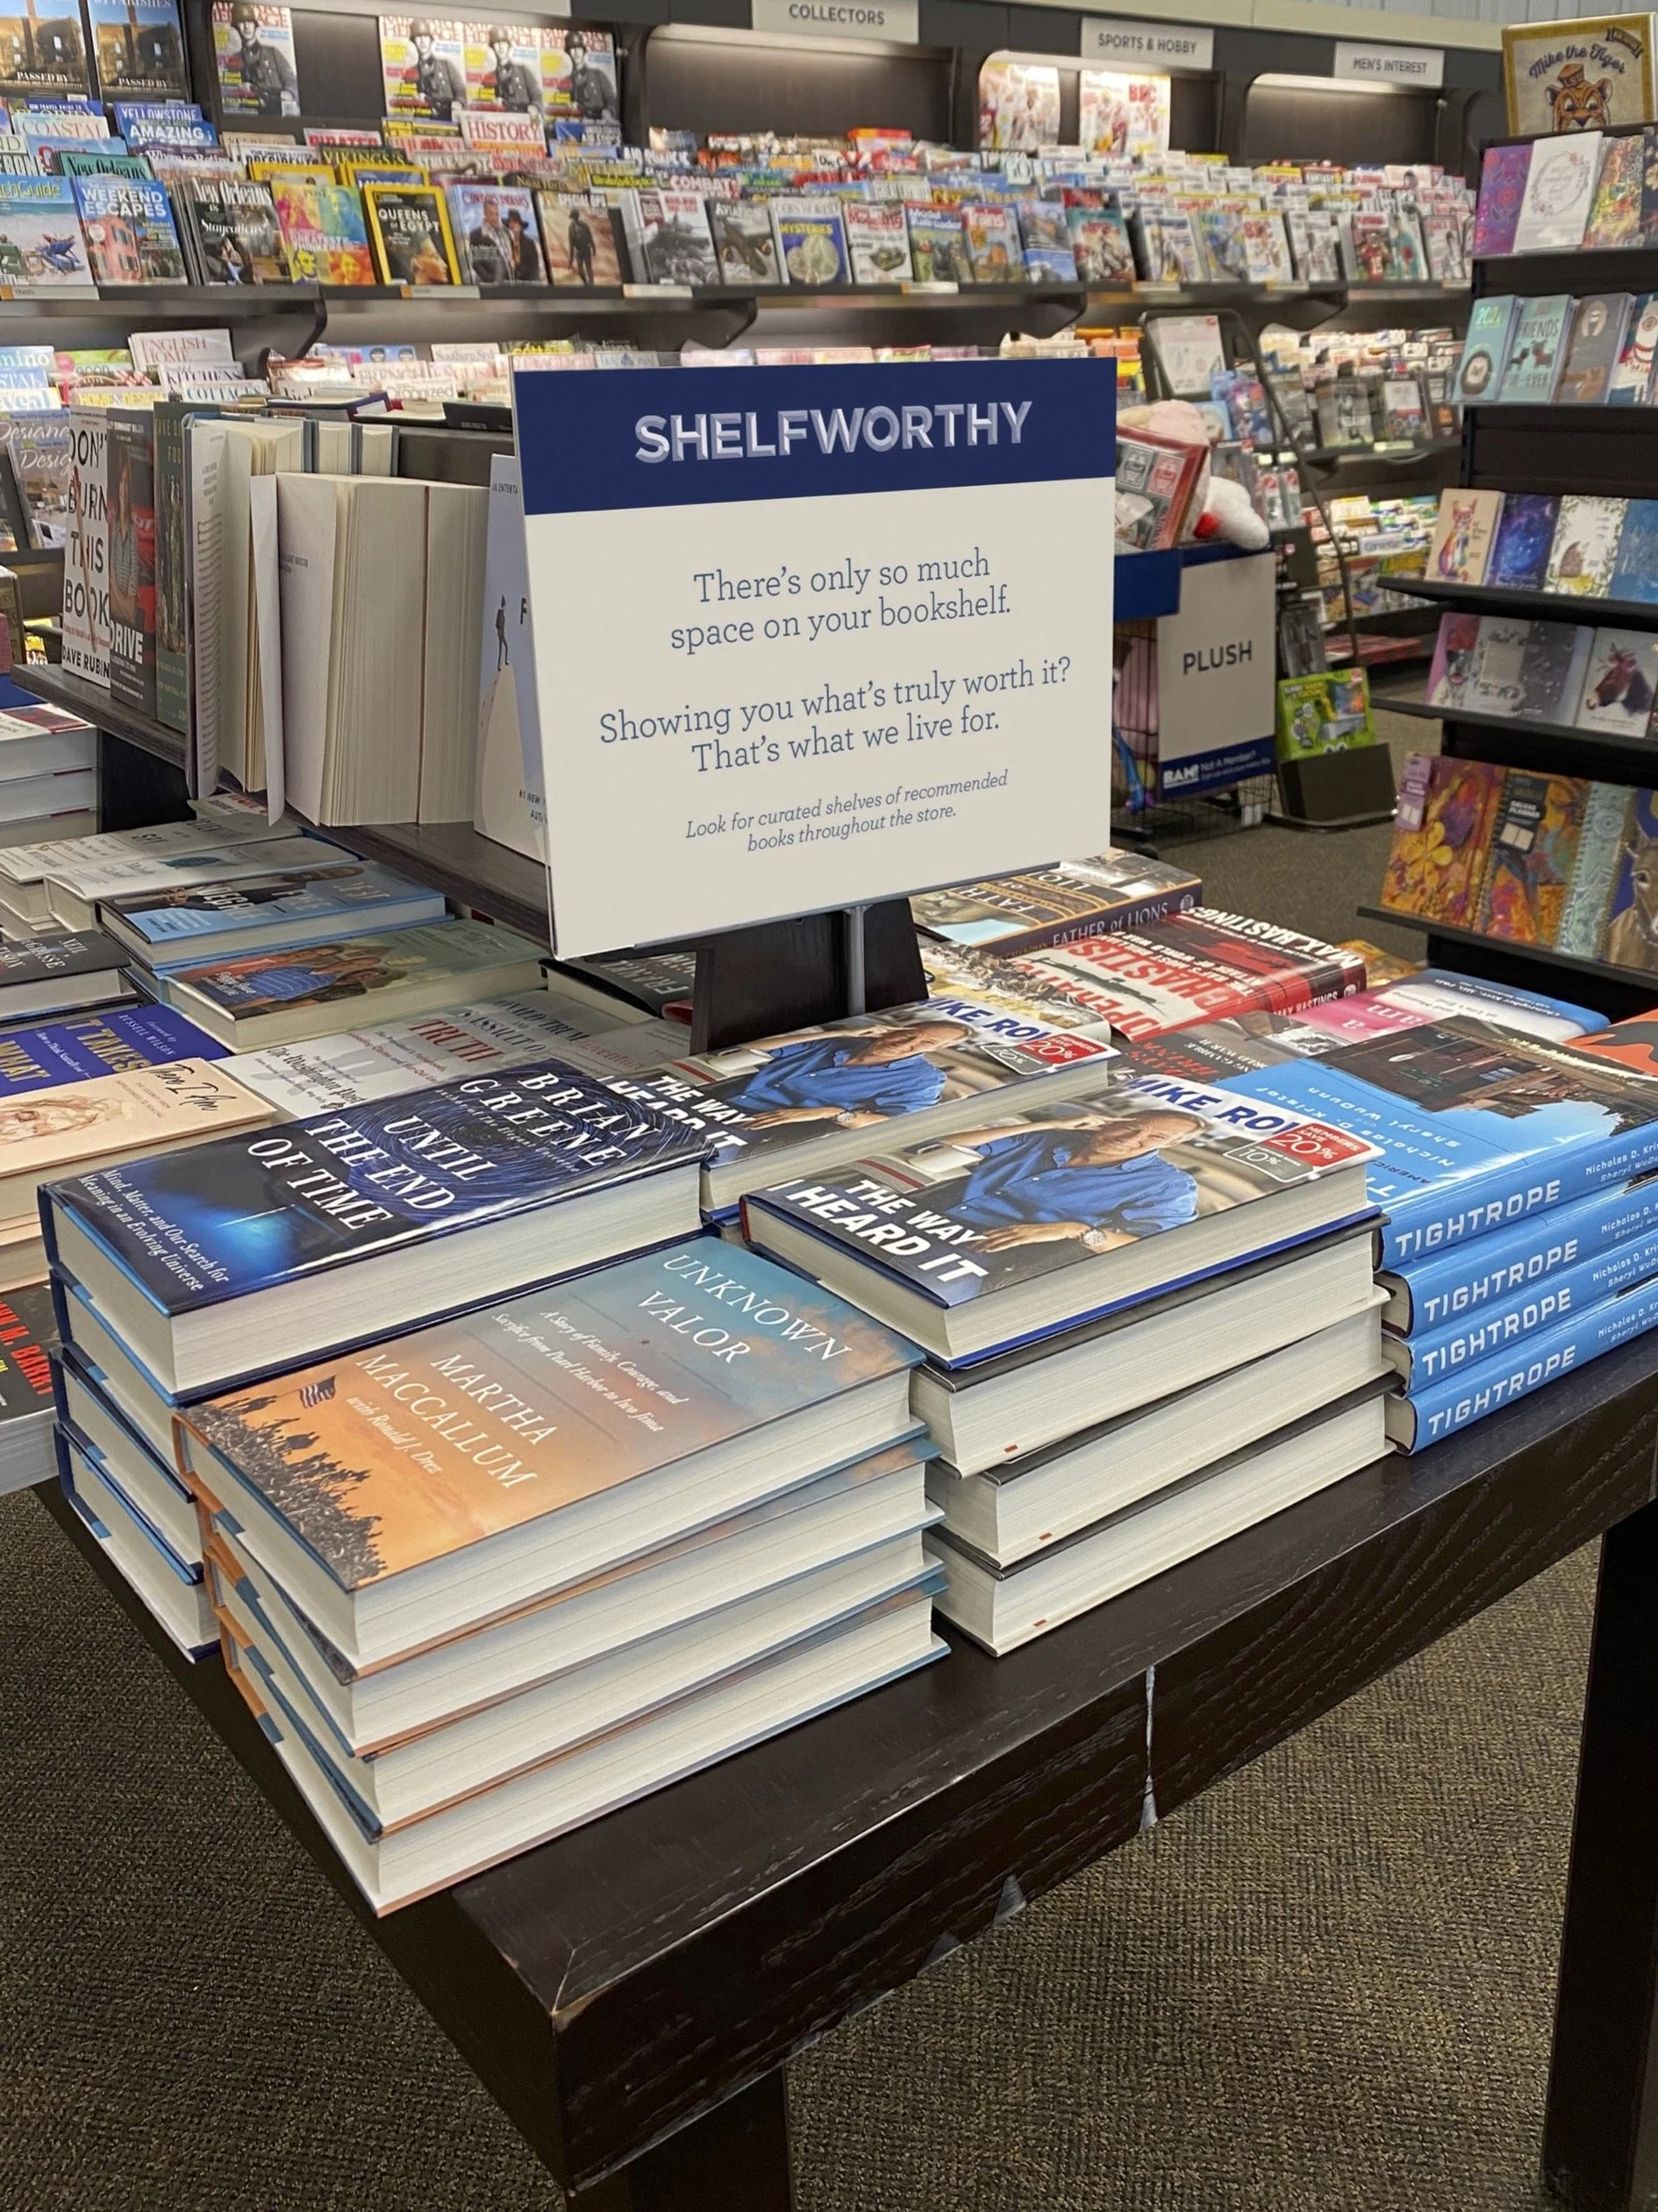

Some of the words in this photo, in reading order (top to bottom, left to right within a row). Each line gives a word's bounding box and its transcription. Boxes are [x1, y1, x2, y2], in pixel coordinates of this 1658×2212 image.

[789, 4, 886, 27] COLLECTORS
[1097, 32, 1143, 51] SPORTS
[1145, 37, 1155, 51] &
[1157, 38, 1197, 55] HOBBY
[1529, 52, 1562, 78] Mike
[1565, 44, 1588, 59] the
[1589, 43, 1626, 75] Tiger
[1353, 56, 1381, 72] MEN'S
[1383, 58, 1428, 75] INTEREST
[22, 119, 103, 138] COASTAL
[120, 107, 198, 121] YELLOWSTONE
[467, 121, 541, 142] HISTORY
[129, 125, 204, 140] AMAZING
[82, 188, 163, 203] WEEKEND
[219, 178, 273, 205] Orleans
[84, 202, 168, 218] ESCAPES
[378, 208, 429, 221] QUEENS
[400, 220, 440, 232] EGYPT
[141, 336, 207, 350] ENGLISH
[1518, 318, 1561, 339] FRIENDS
[167, 369, 243, 384] KITCHENS
[185, 382, 263, 401] COTTAGES
[634, 400, 1033, 464] SHELFWORTHY
[694, 566, 801, 603] There's
[811, 558, 871, 595] only
[880, 566, 907, 585] so
[918, 546, 990, 582] much
[671, 622, 754, 655] space
[764, 617, 800, 639] on
[808, 610, 871, 641] your
[878, 584, 1010, 626] bookshelf.
[110, 619, 144, 665] DRIVE
[1183, 640, 1253, 675] PLUSH
[62, 645, 82, 667] DAVE
[83, 652, 111, 679] RUBIN
[601, 705, 731, 743] Showing
[740, 701, 793, 731] you
[801, 681, 885, 716] what's
[894, 670, 956, 704] truly
[963, 660, 1033, 695] worth
[1042, 656, 1070, 684] it?
[692, 735, 779, 772] That's
[788, 725, 854, 758] what
[862, 726, 898, 747] we
[907, 712, 952, 741] live
[961, 704, 998, 733] for.
[686, 815, 725, 838] Look
[733, 812, 754, 830] for
[759, 799, 821, 825] curated
[826, 793, 882, 814] shelves
[886, 786, 902, 804] of
[904, 769, 1007, 801] recommended
[1509, 806, 1540, 819] PLANNER
[748, 829, 794, 852] books
[798, 816, 886, 843] throughout
[890, 809, 912, 827] the
[917, 807, 955, 822] store.
[195, 885, 272, 920] DEGREE
[1052, 921, 1106, 948] FATHER
[1110, 916, 1125, 932] of
[1127, 902, 1169, 924] LIONS
[1186, 905, 1301, 948] HASTINGS
[59, 937, 89, 954] NEIL
[1152, 944, 1195, 966] WORLD
[1153, 948, 1191, 968] MOST
[1297, 936, 1364, 969] MAX
[1214, 964, 1266, 987] ATTACK
[1296, 991, 1339, 1013] HASTINGS
[76, 1027, 154, 1074] TAKES
[147, 1034, 176, 1056] WILSON
[406, 1018, 505, 1064] TRUTH
[1021, 1040, 1078, 1060] 20%
[282, 1054, 342, 1092] Washington
[329, 1087, 369, 1105] Post
[518, 1072, 663, 1142] BRIAN
[646, 1075, 705, 1102] THE
[690, 1098, 756, 1125] WAY
[1254, 1086, 1327, 1118] Kristof
[1307, 1086, 1382, 1121] WuDunn
[459, 1079, 628, 1167] GREENE
[704, 1131, 748, 1150] IT
[1306, 1124, 1361, 1152] MEMBERS
[1387, 1119, 1461, 1149] Sheryl
[382, 1115, 498, 1182] UNTIL
[1240, 1147, 1282, 1167] 10%
[1267, 1132, 1340, 1160] 20%
[1360, 1129, 1455, 1167] Nicholas
[304, 1118, 368, 1170] THE
[364, 1166, 456, 1211] END
[1584, 1153, 1628, 1176] Nicholas
[247, 1138, 313, 1171] OF
[286, 1168, 394, 1231] TIME
[765, 1178, 807, 1192] I
[100, 1168, 132, 1195] Mind,
[122, 1188, 155, 1221] Matter,
[164, 1227, 186, 1246] Our
[180, 1242, 218, 1272] Search
[785, 1185, 932, 1257] HEARD
[844, 1179, 917, 1215] THE
[904, 1209, 990, 1246] WAY
[1394, 1179, 1562, 1258] TIGHTROPE
[1601, 1211, 1640, 1234] Nicholas
[77, 1174, 115, 1207] Meaning
[126, 1220, 167, 1257] Evolving
[160, 1252, 204, 1292] Universe
[917, 1252, 990, 1283] IT
[1423, 1238, 1578, 1323] TIGHTROPE
[1592, 1258, 1632, 1281] Nicholas
[663, 1253, 853, 1362] UNKNOWN
[637, 1290, 752, 1365] VALOR
[1421, 1287, 1572, 1377] TIGHTROPE
[1597, 1314, 1636, 1338] Nicholas
[491, 1313, 531, 1342] Sacrifice
[546, 1349, 581, 1369] Pearl
[569, 1365, 610, 1394] Harbor
[627, 1410, 665, 1432] Jima
[582, 1333, 621, 1363] Family,
[616, 1360, 660, 1390] Courage,
[655, 1388, 690, 1404] and
[430, 1353, 558, 1445] MARTHA
[1427, 1344, 1576, 1437] TIGHTROPE
[346, 1396, 381, 1416] with
[367, 1413, 411, 1443] Ronald
[354, 1353, 539, 1489] MACCALLUM
